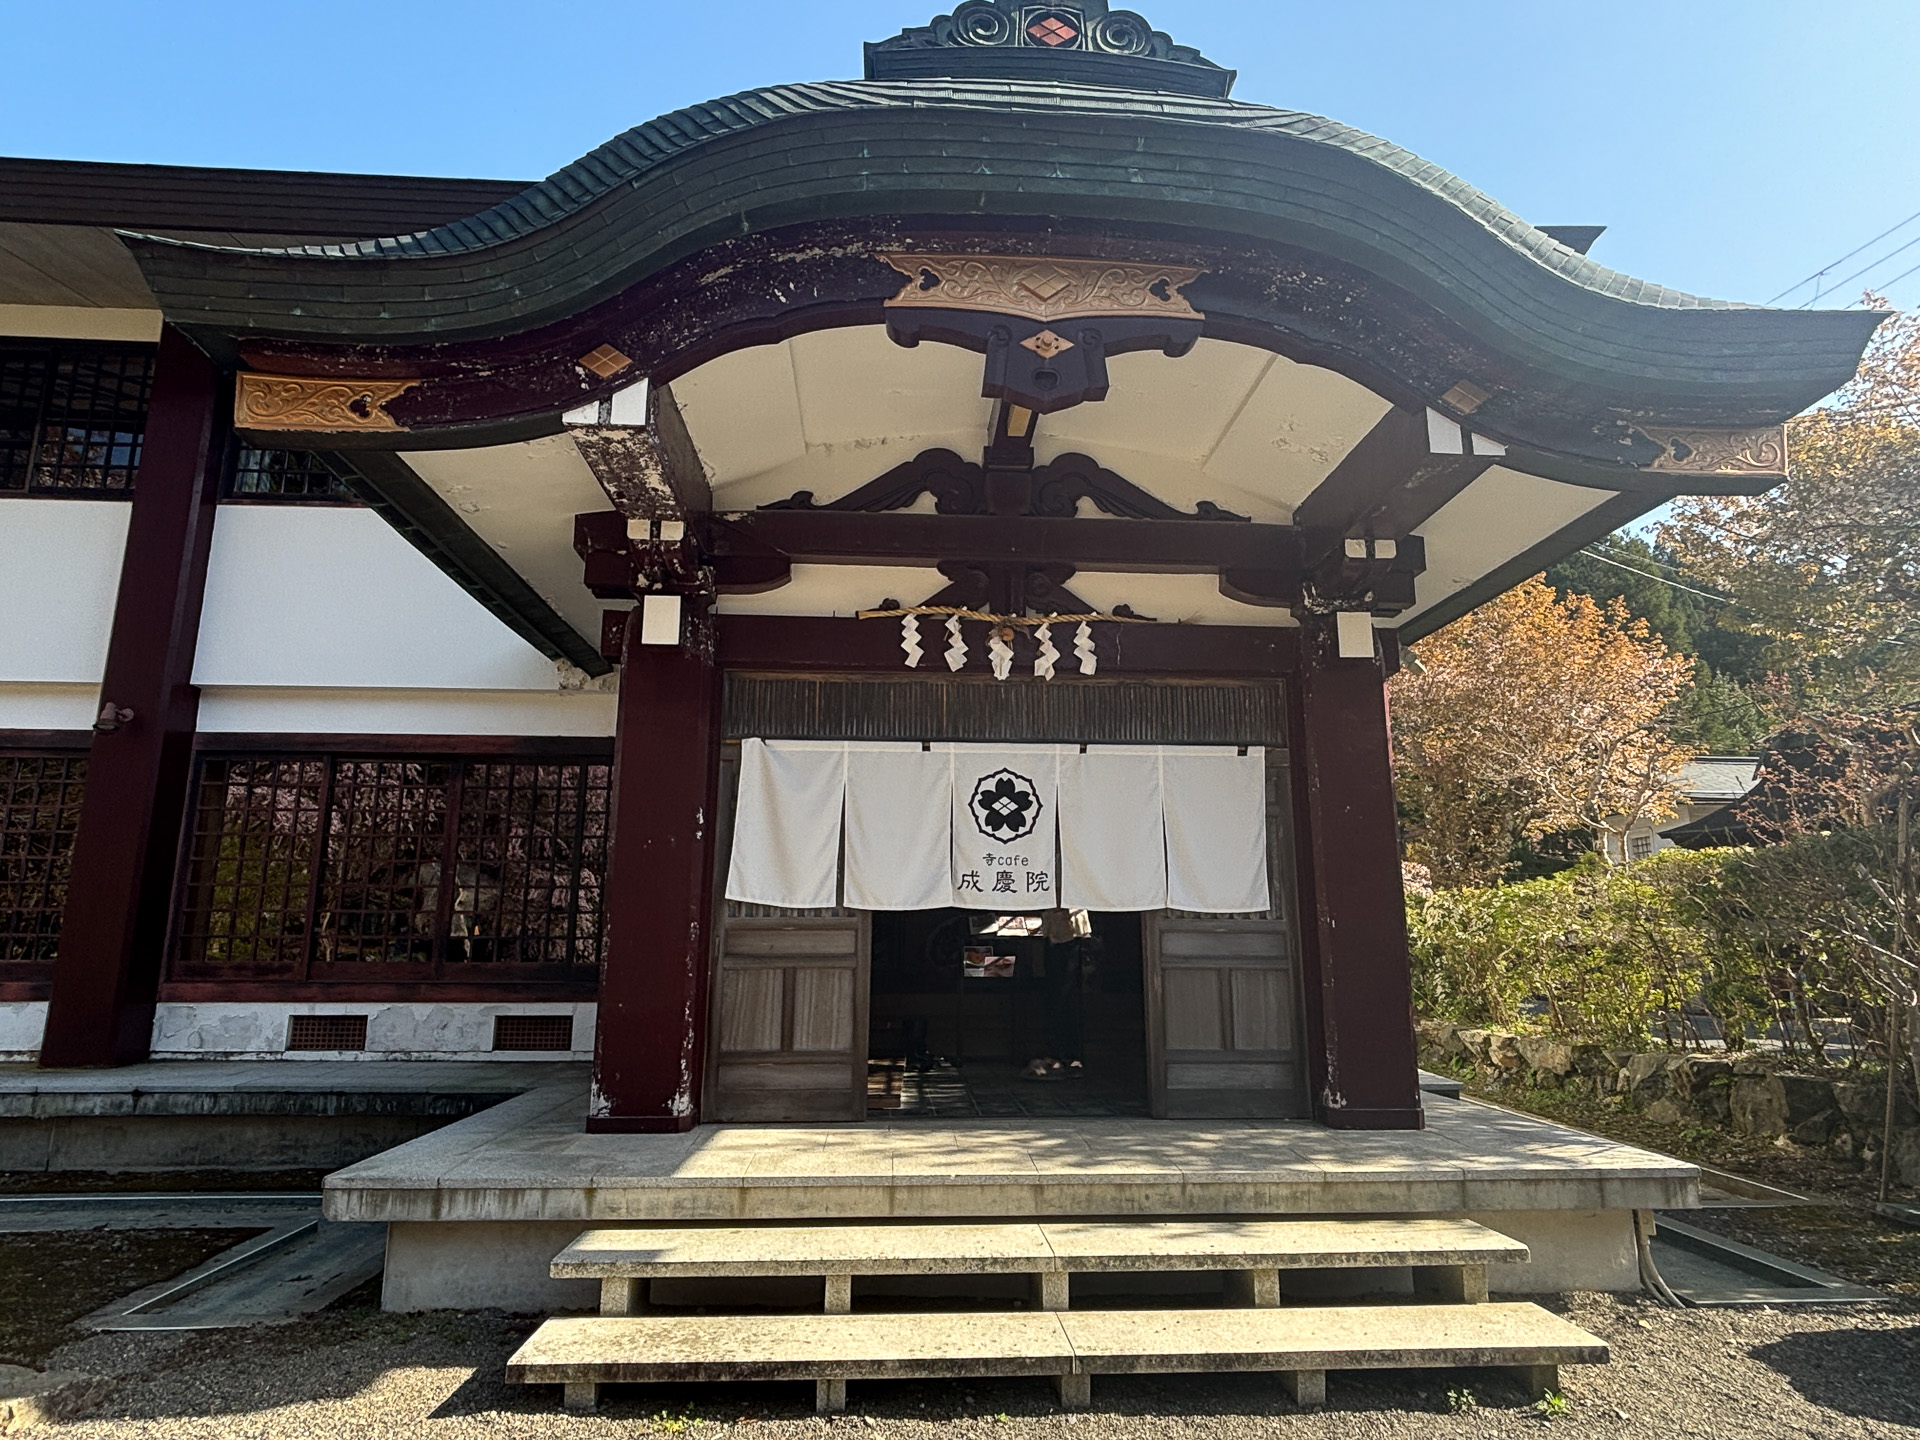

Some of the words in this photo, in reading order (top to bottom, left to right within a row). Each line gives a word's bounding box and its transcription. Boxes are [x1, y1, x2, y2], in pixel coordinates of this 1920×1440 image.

[982, 852, 1029, 866] 寺cafe
[957, 870, 1050, 893] 成慶院
